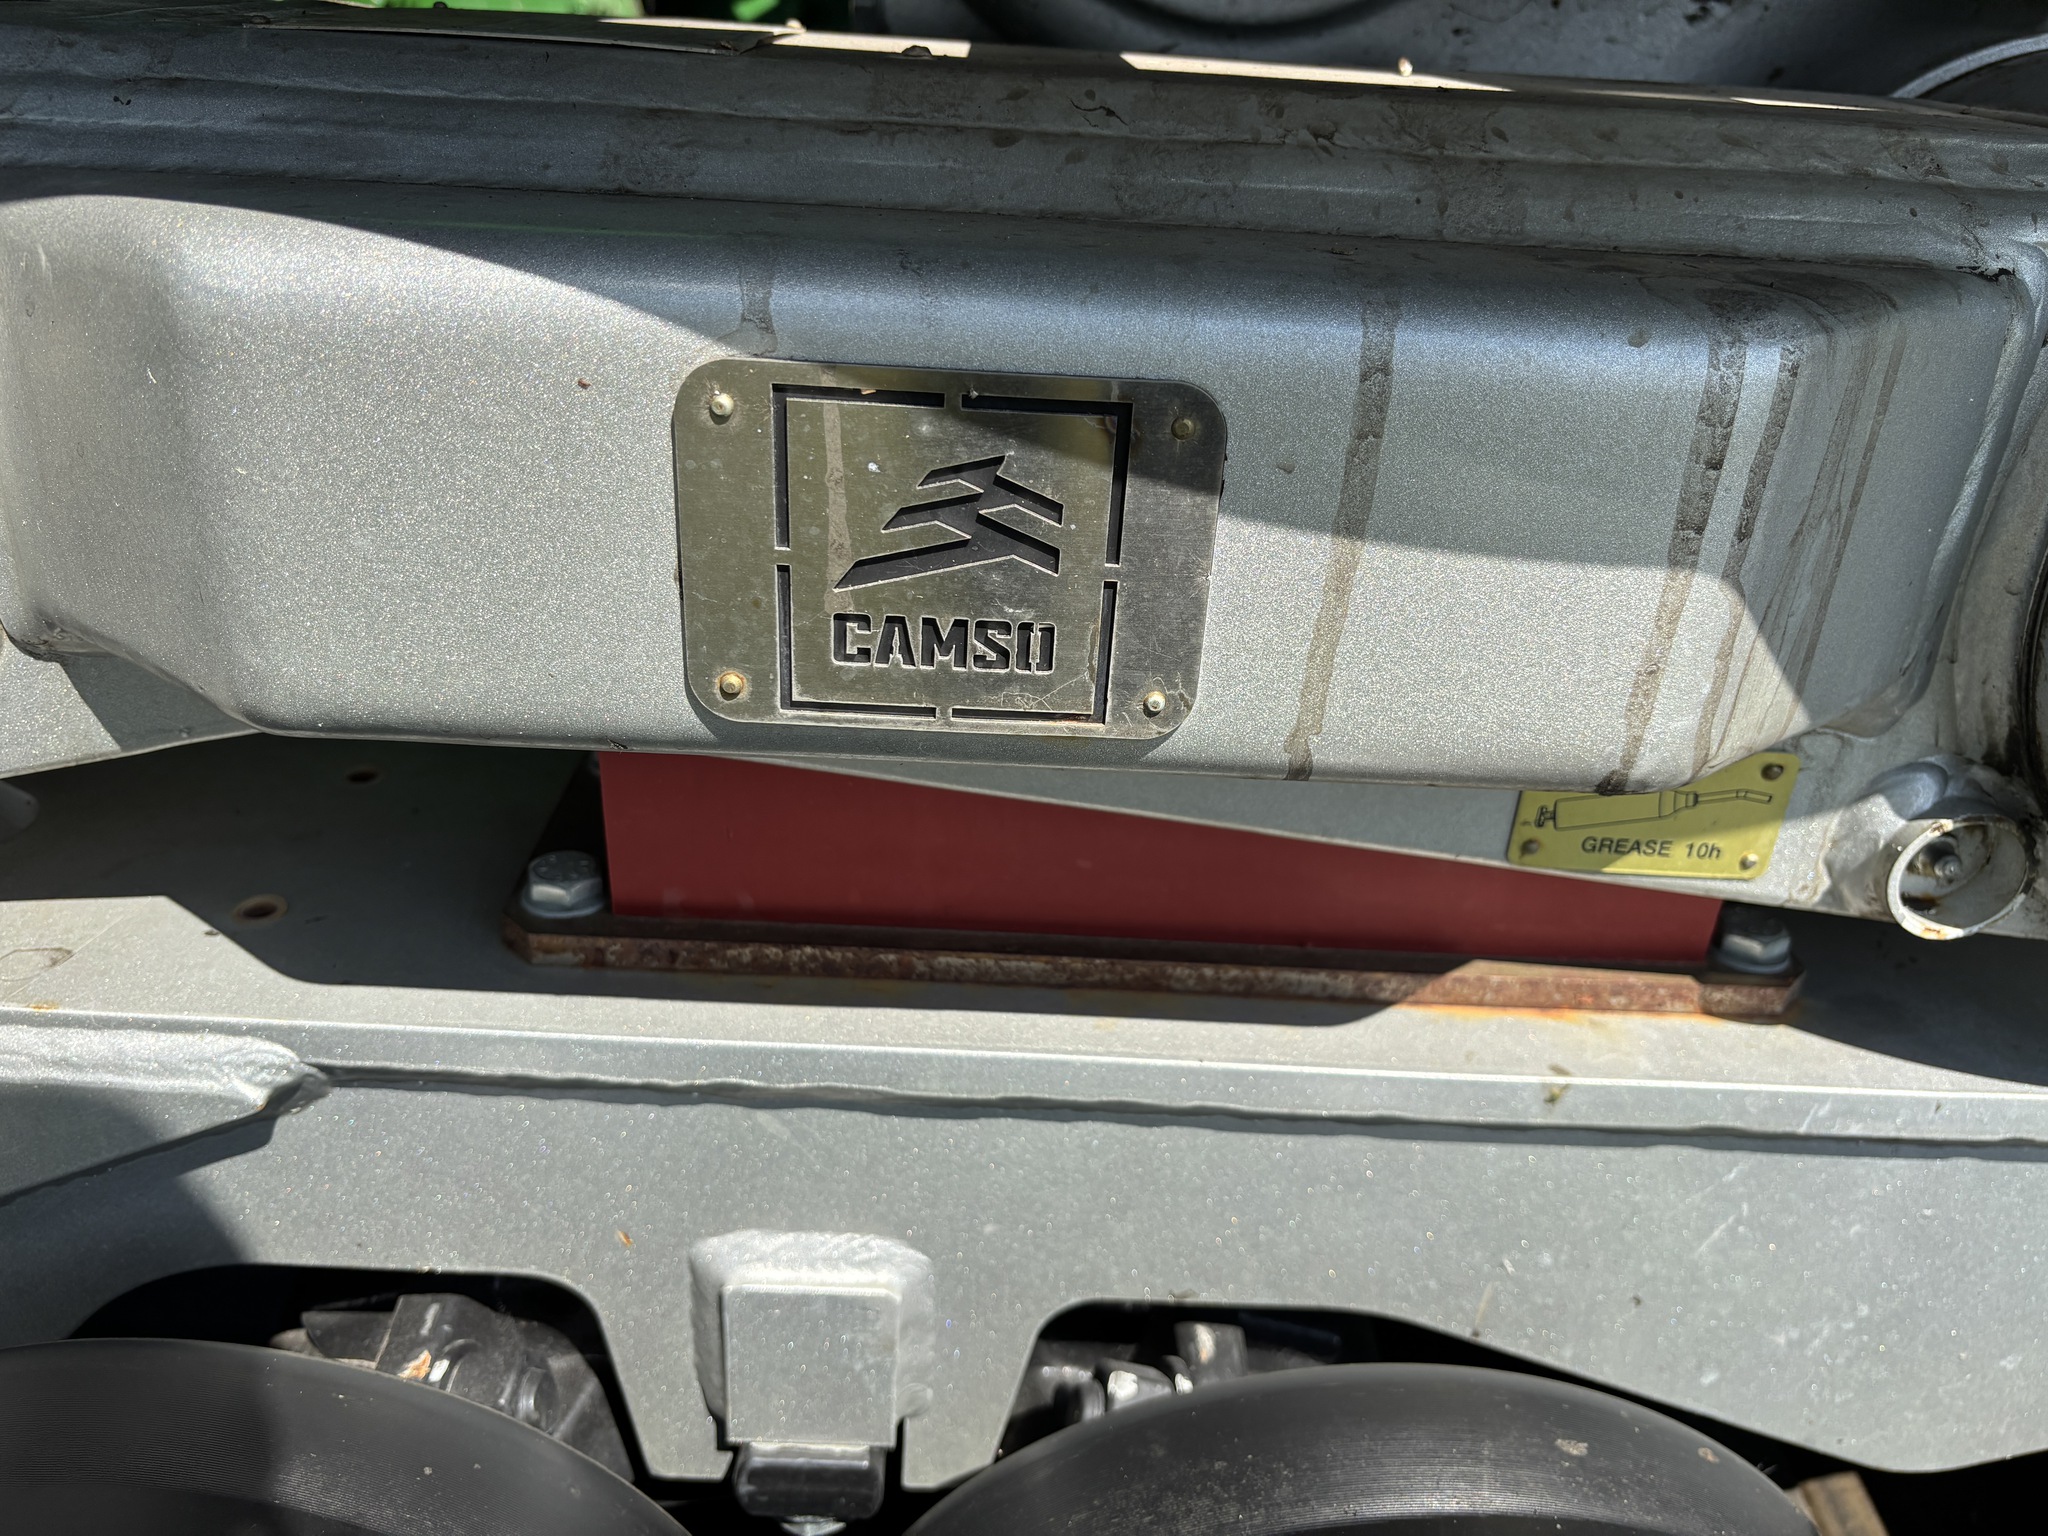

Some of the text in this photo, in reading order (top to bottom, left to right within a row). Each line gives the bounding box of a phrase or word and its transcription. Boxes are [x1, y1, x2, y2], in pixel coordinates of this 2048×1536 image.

[832, 612, 1057, 675] CAMSO
[1581, 836, 1721, 860] GREASE 10h
